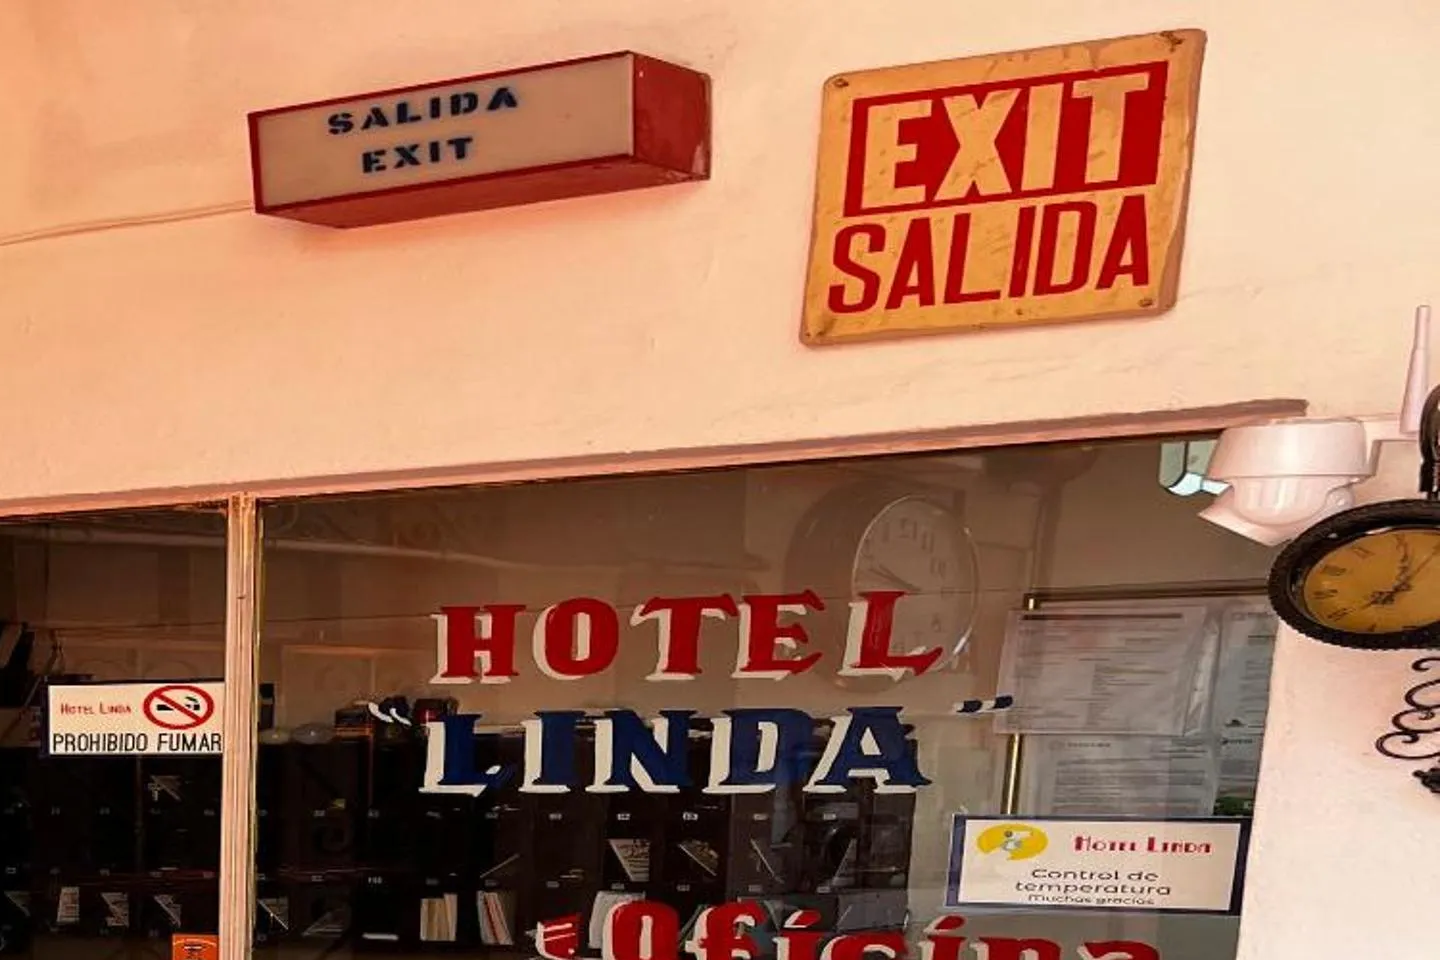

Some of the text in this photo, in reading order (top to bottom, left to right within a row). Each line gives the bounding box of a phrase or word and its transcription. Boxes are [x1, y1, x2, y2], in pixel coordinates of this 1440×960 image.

[327, 86, 518, 135] SALIDA
[362, 136, 474, 174] EXIT
[866, 72, 1151, 212] EXIT
[826, 195, 1151, 315] SALIDA
[429, 588, 944, 685] HOTEL
[52, 732, 222, 753] PROHIBIDO FUMAR
[1015, 880, 1172, 897] temperatura
[1031, 867, 1160, 882] Control de
